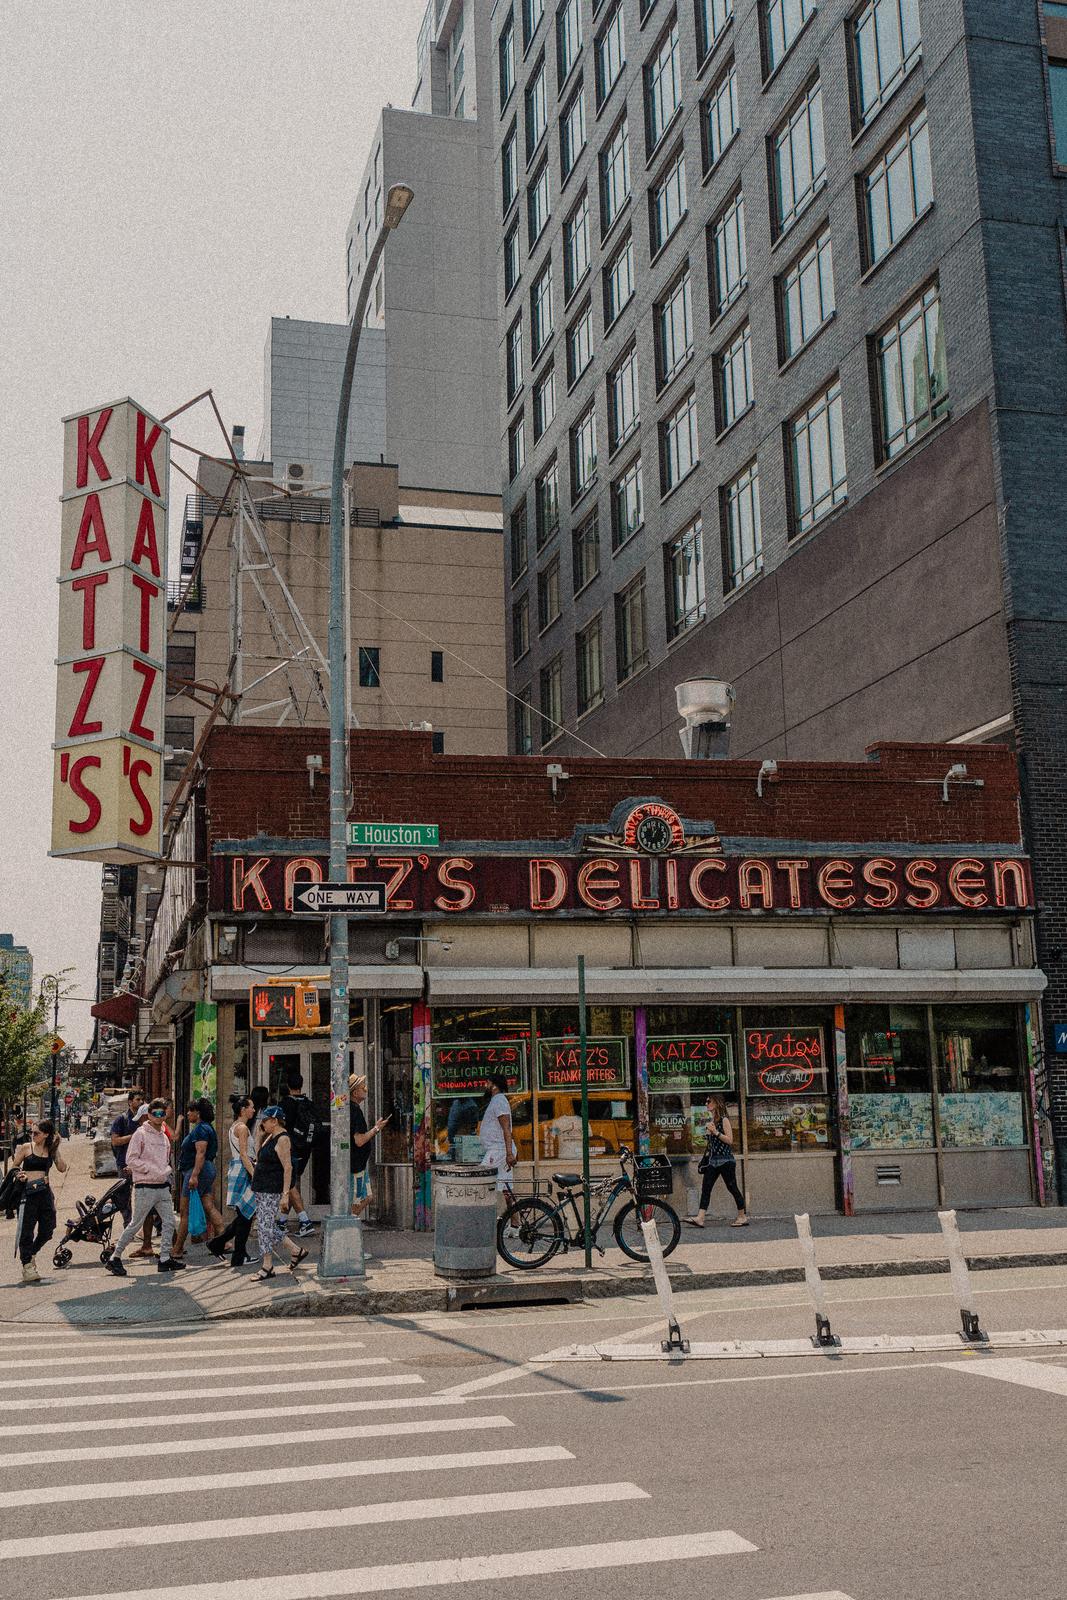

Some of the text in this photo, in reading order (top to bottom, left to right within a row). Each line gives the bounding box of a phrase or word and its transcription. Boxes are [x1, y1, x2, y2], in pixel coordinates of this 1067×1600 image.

[60, 408, 113, 834] KATZ'S
[123, 412, 161, 836] KATZ'S
[352, 826, 436, 844] E Houston St
[529, 858, 1028, 911] DELICATESSEN
[307, 892, 374, 904] ONE WAY
[283, 995, 294, 1020] 4
[652, 1040, 718, 1060] KATZ'S
[548, 1068, 616, 1083] FRANKRTERS
[655, 1117, 687, 1126] HOLIDAY
